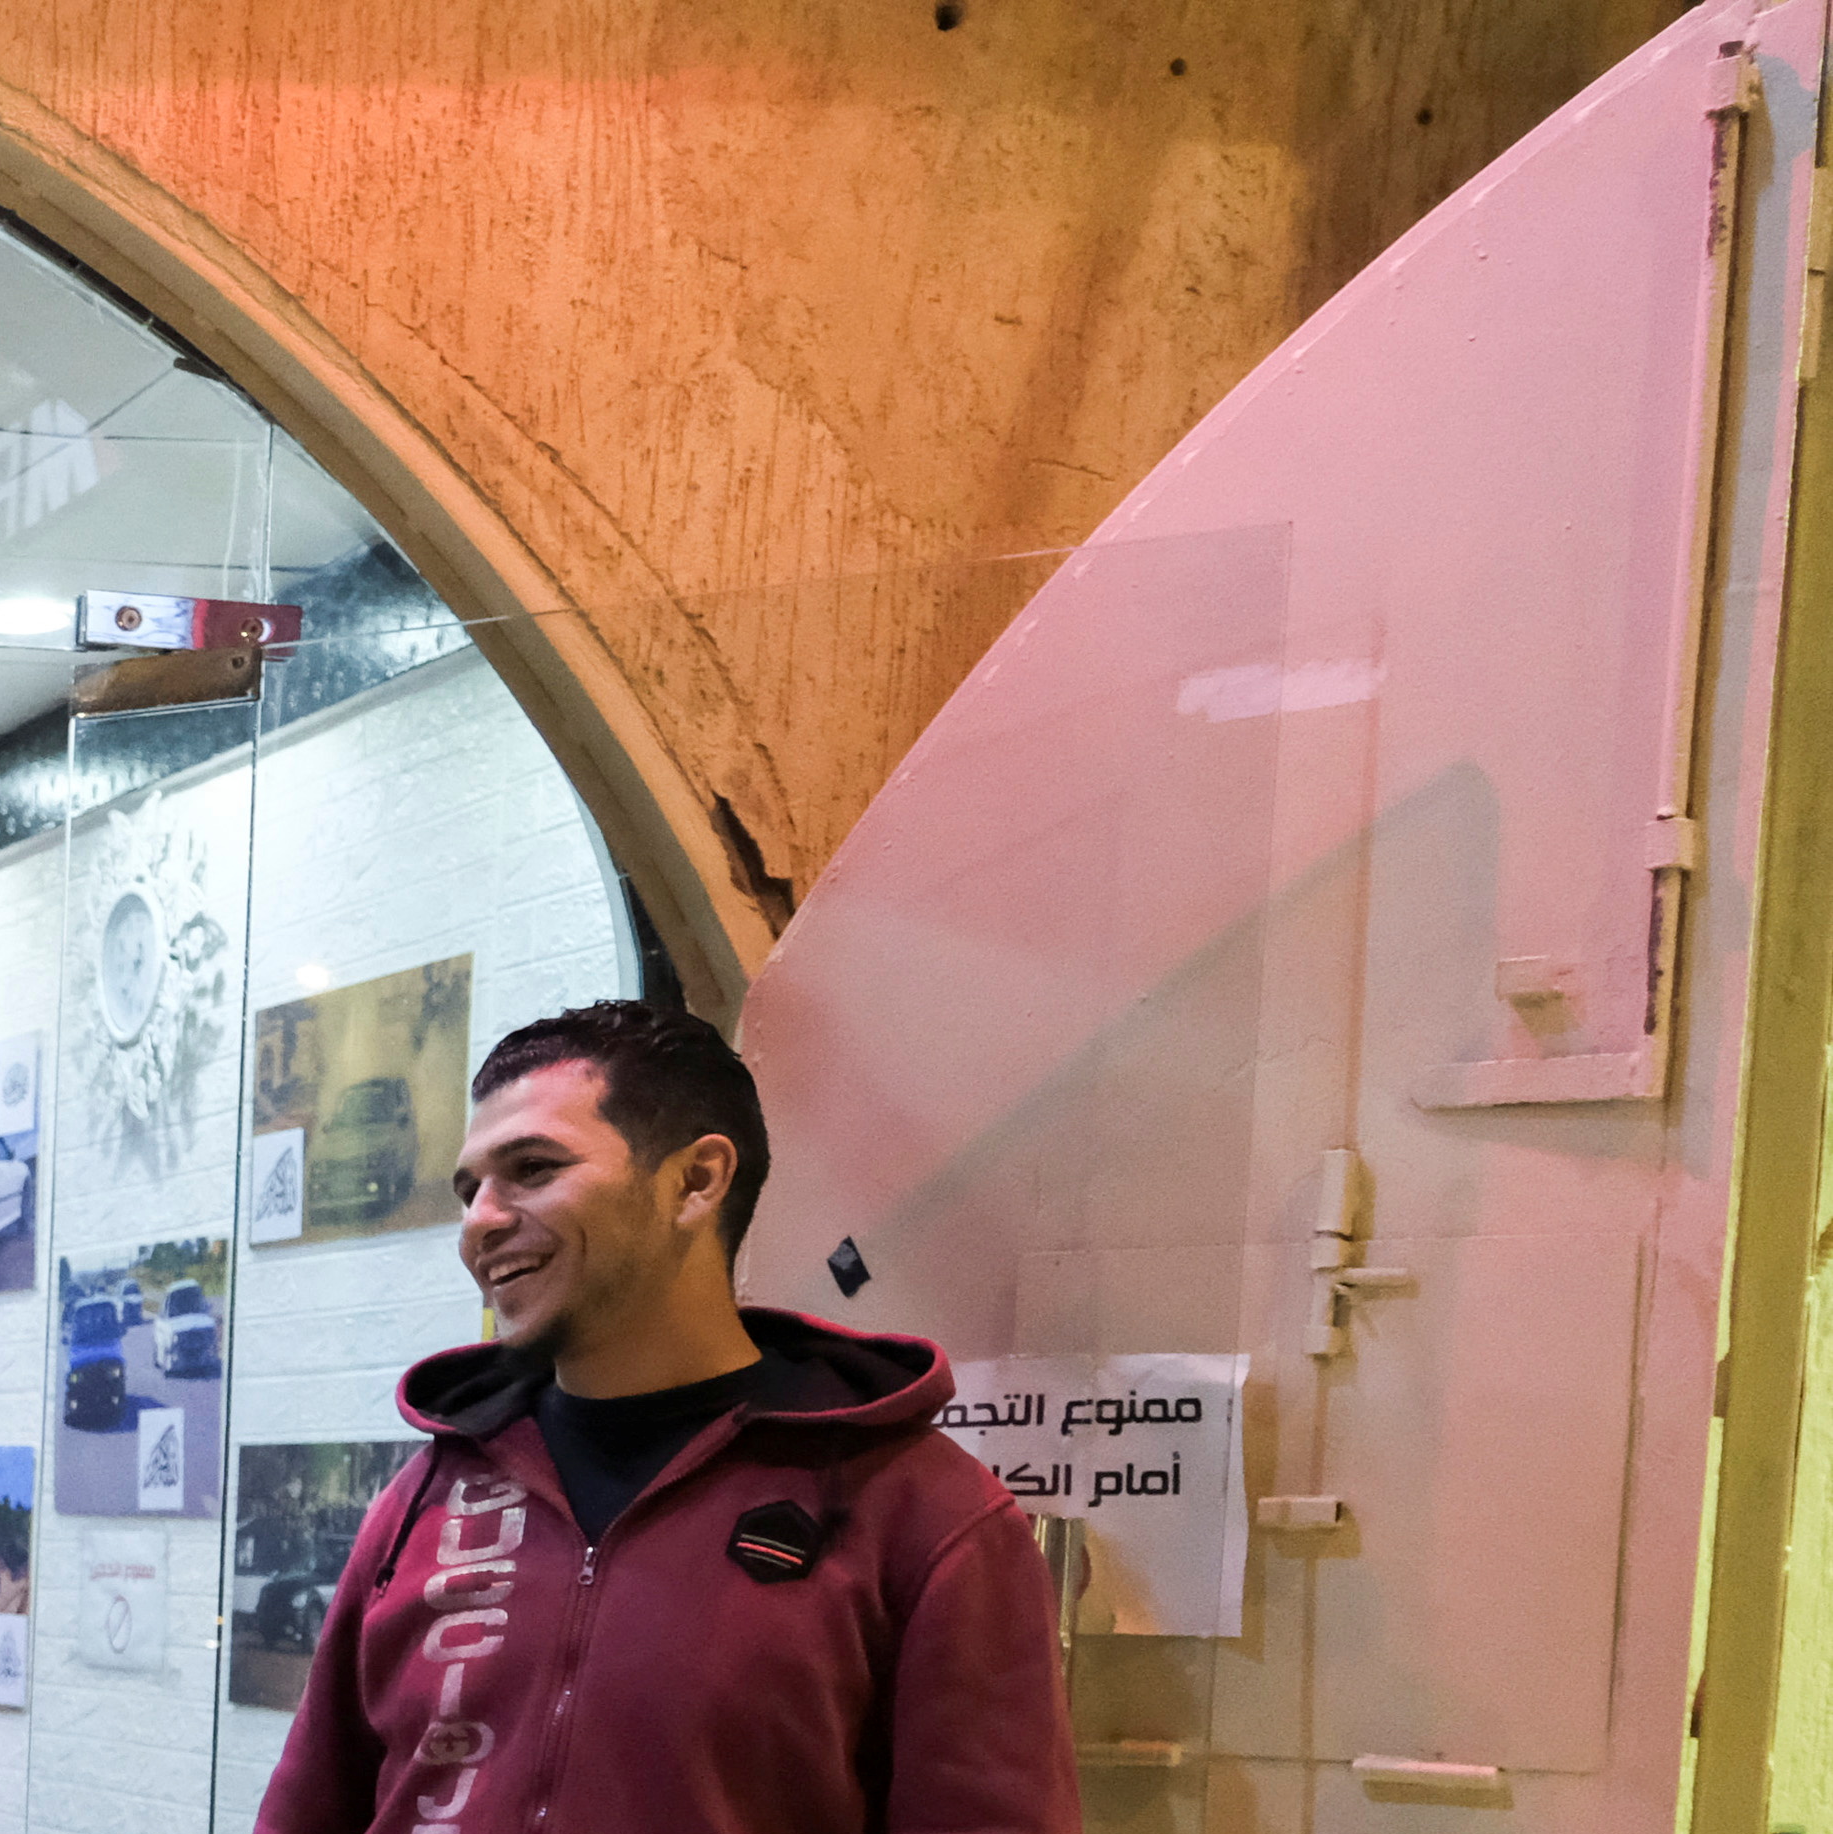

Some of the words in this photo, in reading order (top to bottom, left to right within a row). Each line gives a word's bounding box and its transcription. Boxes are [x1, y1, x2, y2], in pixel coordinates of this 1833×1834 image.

[931, 1393, 1046, 1436] التجم
[1061, 1391, 1203, 1436] ممنوع
[1088, 1451, 1181, 1508] أمام
[422, 1474, 529, 1717] GUCCI
